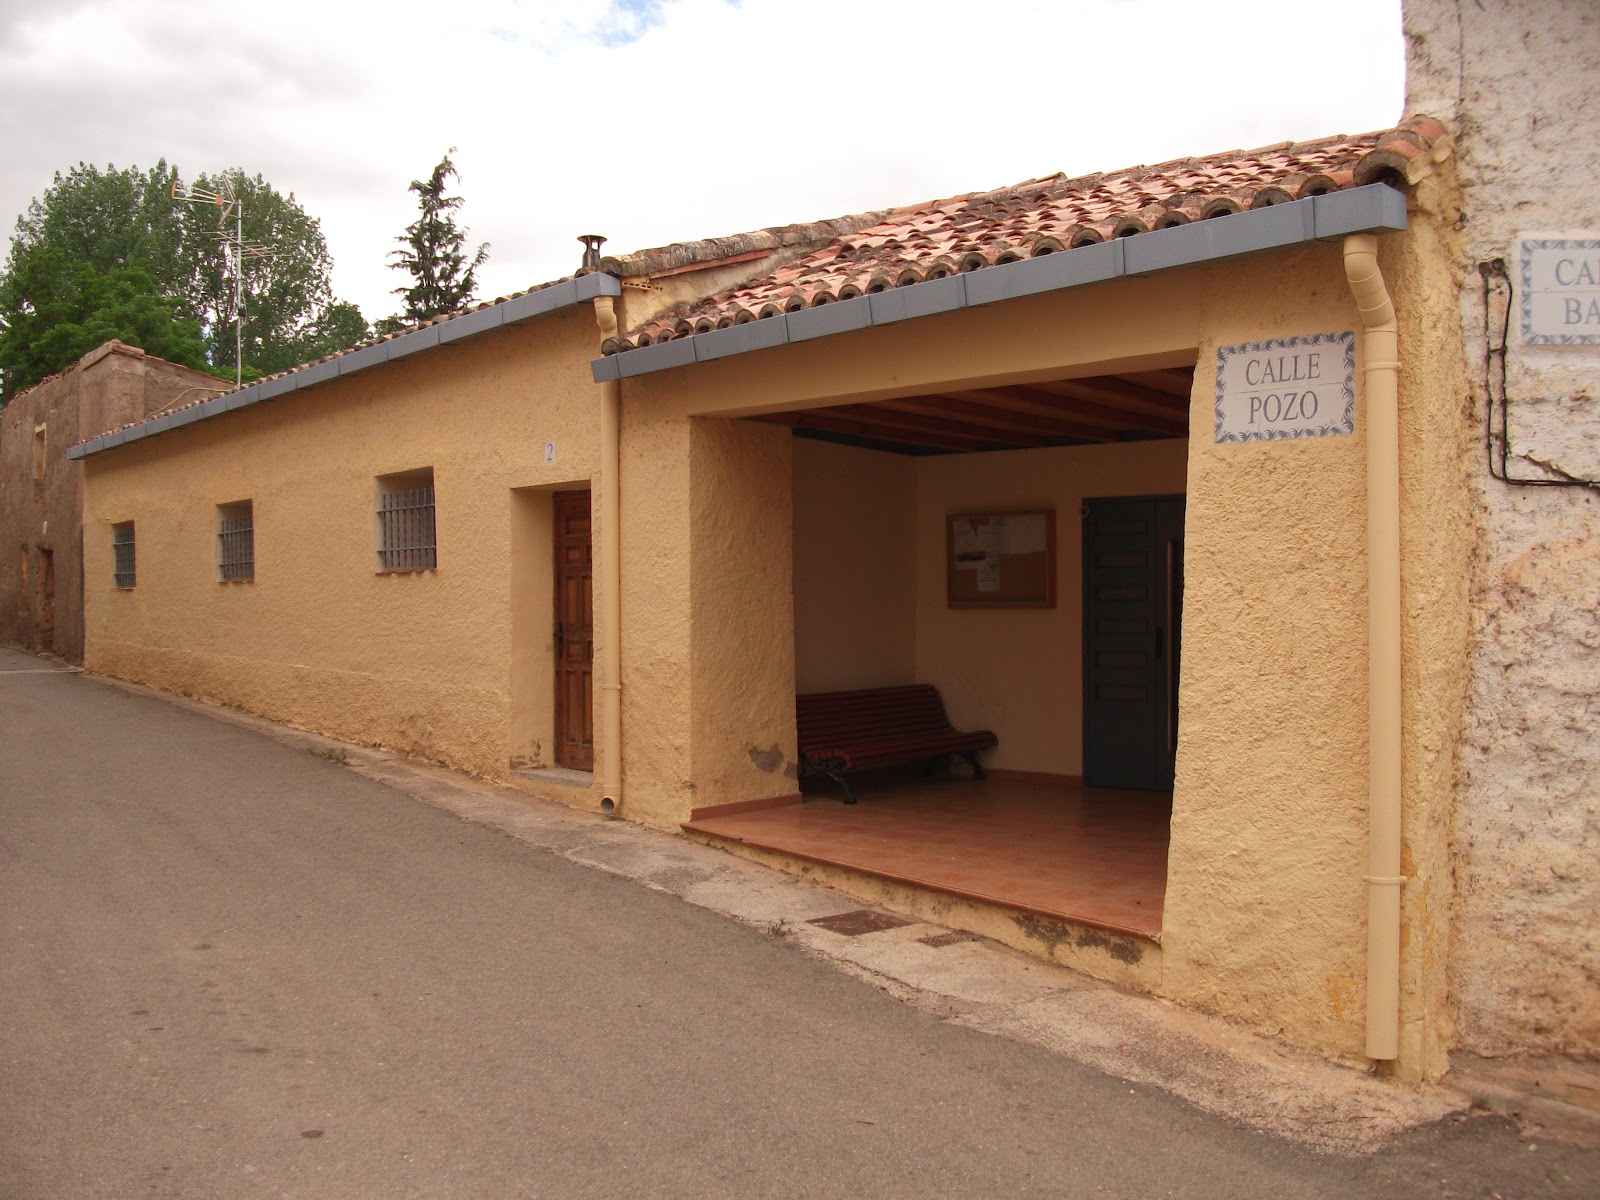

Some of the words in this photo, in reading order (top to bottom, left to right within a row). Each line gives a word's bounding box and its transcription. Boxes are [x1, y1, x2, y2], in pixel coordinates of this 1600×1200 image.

[1554, 259, 1600, 286] CA
[1245, 353, 1321, 386] CALLE
[1248, 390, 1319, 425] POZO
[546, 443, 554, 461] 2
